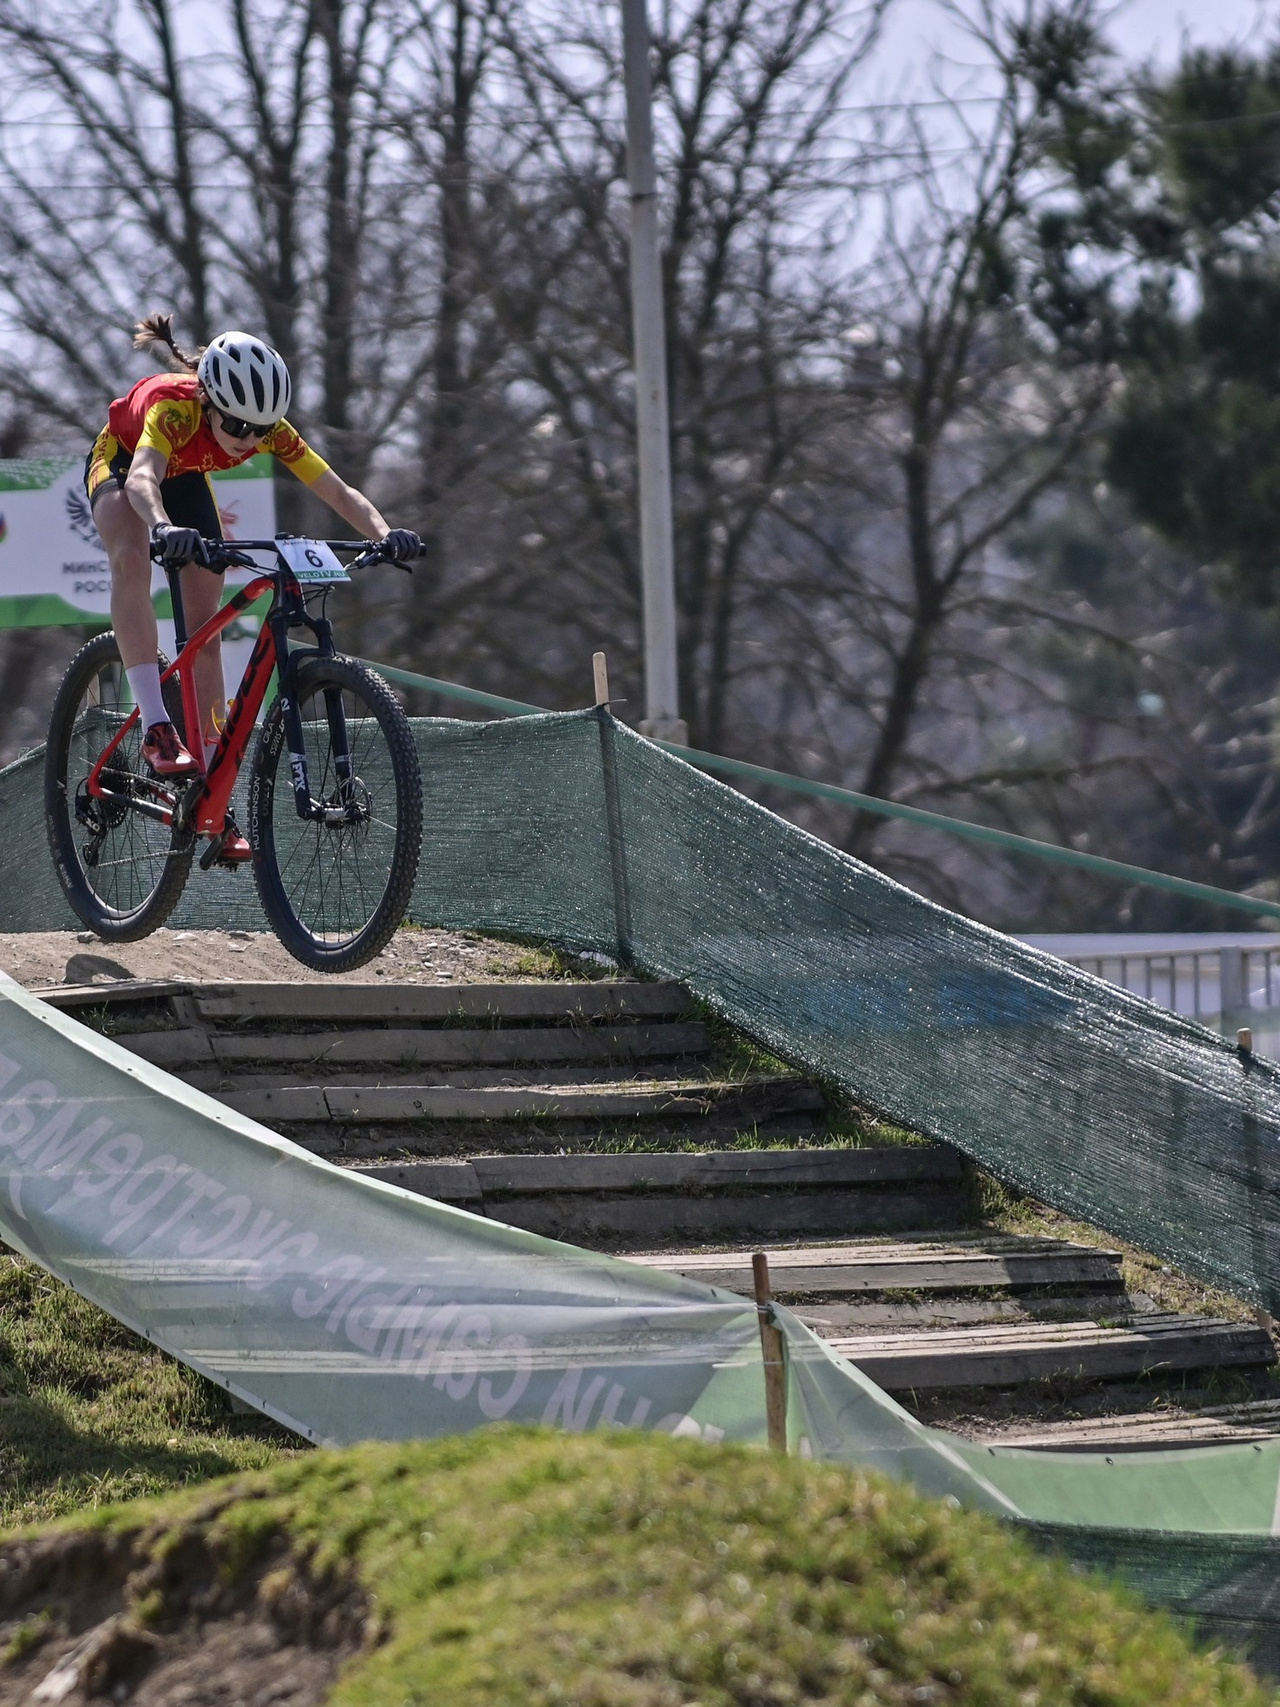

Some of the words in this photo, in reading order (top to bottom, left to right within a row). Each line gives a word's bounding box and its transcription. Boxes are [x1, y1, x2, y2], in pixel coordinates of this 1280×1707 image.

[62, 561, 109, 573] МИНС
[304, 548, 324, 568] 6
[291, 762, 306, 791] FOX
[252, 775, 261, 850] HUTCHINSON
